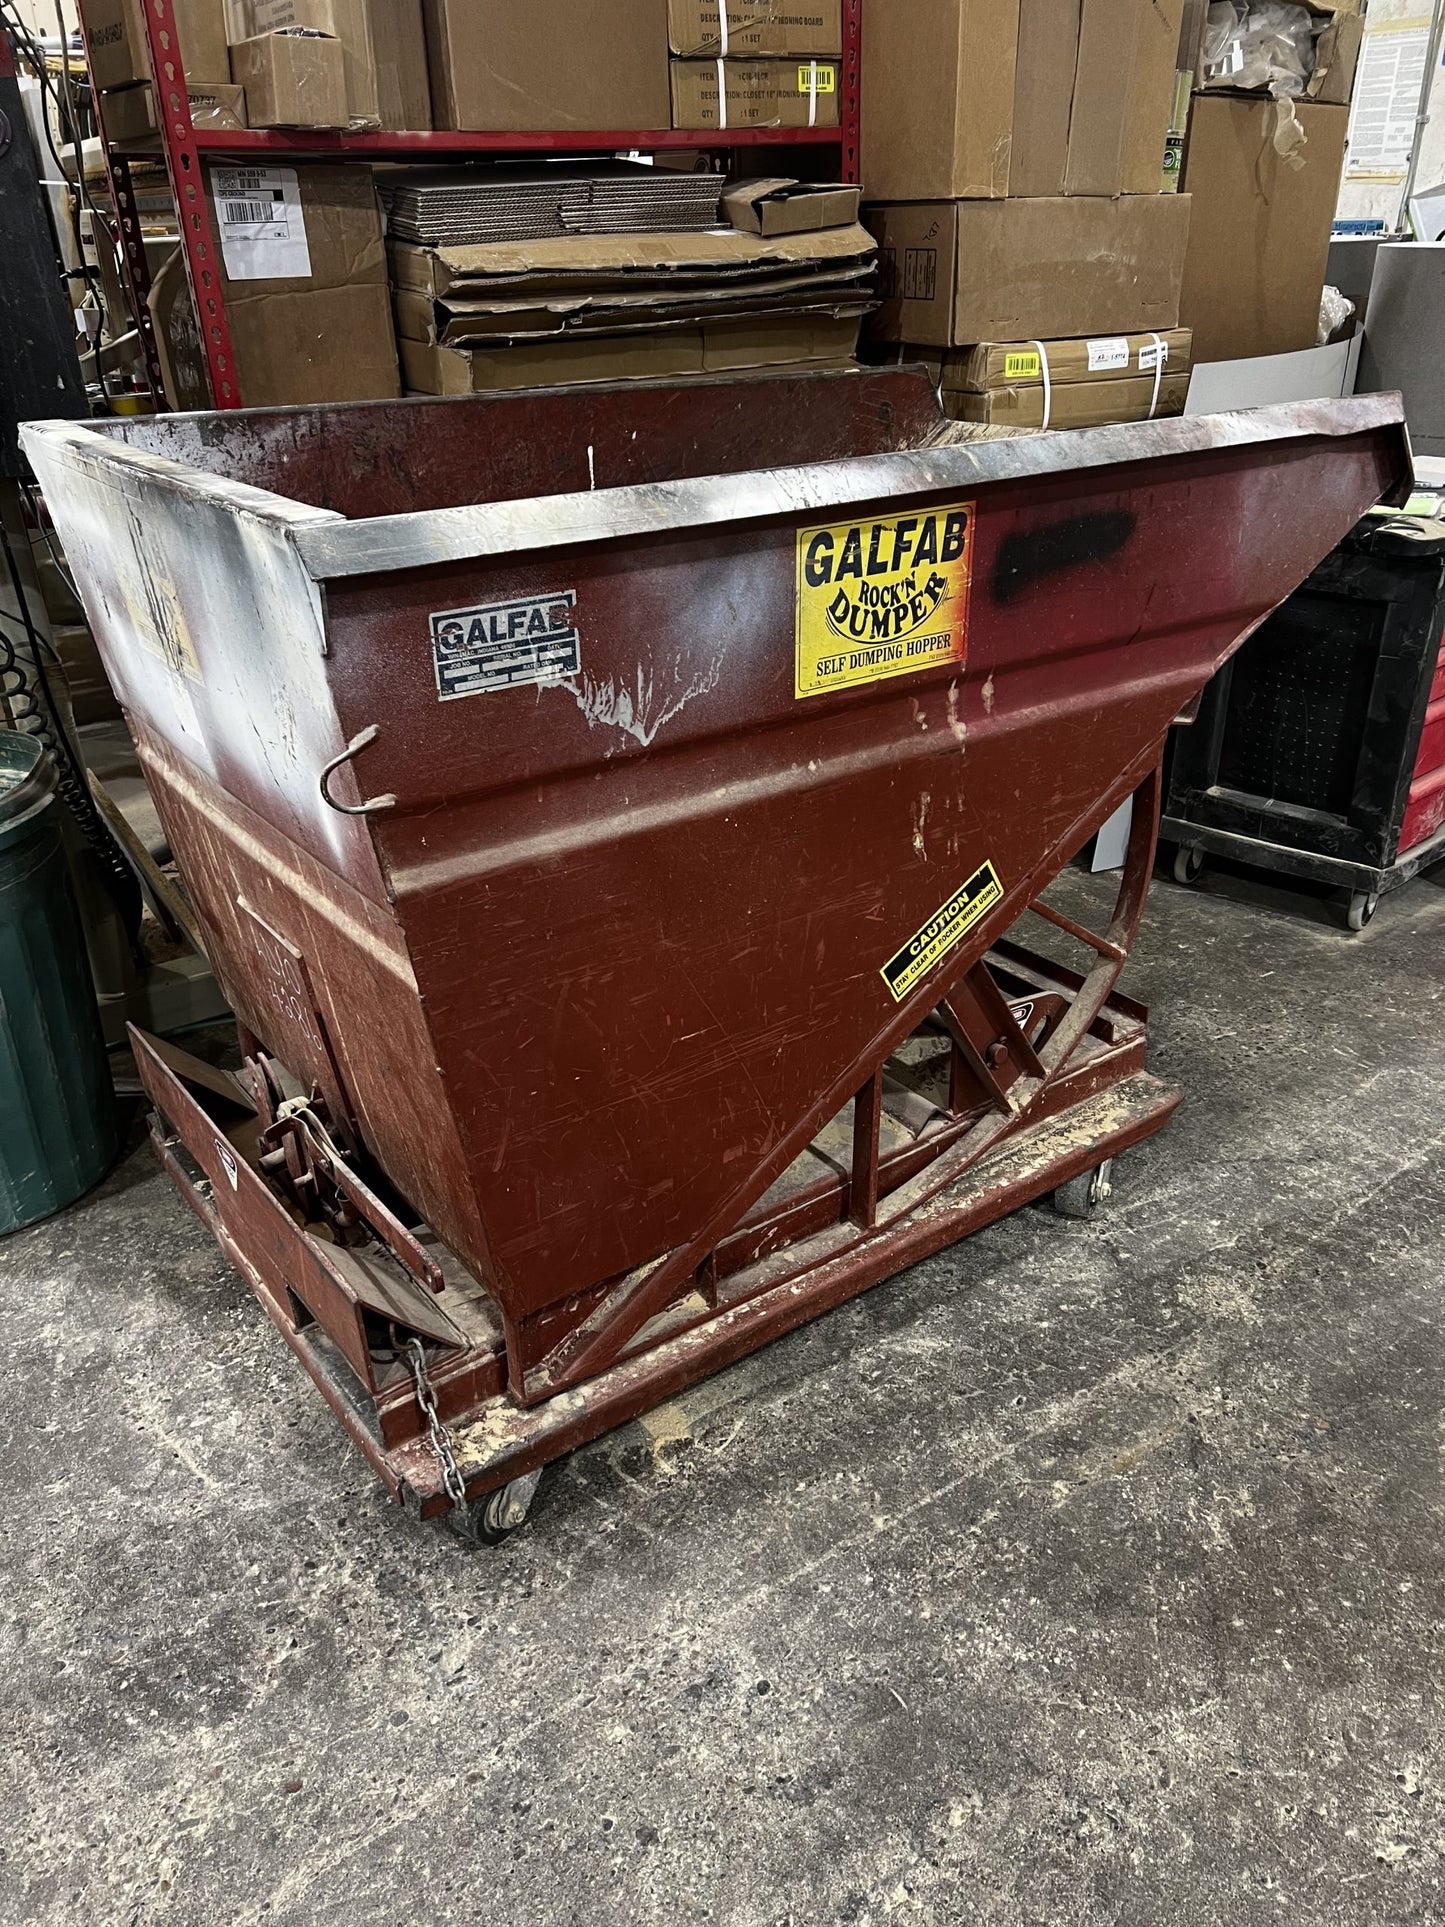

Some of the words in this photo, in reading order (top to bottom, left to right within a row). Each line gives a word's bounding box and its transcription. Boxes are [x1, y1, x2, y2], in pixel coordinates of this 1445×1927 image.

[778, 16, 802, 25] IRONING
[804, 17, 824, 26] BOARD
[750, 34, 760, 42] SET
[700, 72, 714, 80] ITEM
[743, 90, 764, 99] CLOSET
[702, 110, 714, 118] QTY
[748, 108, 759, 117] SET
[805, 512, 968, 588] GALFAB
[859, 571, 916, 607] ROCK'N
[828, 572, 947, 640] DUMPER
[440, 604, 568, 651] GALFAB
[477, 646, 500, 656] INDIANA
[816, 657, 847, 678] SELF
[849, 644, 902, 669] DUMPING
[906, 634, 952, 654] HOPPER
[450, 662, 460, 670] JOB
[468, 672, 485, 681] MODEL
[910, 892, 970, 956] CAUTION
[895, 972, 910, 990] STAY
[910, 954, 928, 974] CLEAR
[929, 946, 937, 955] OF
[939, 921, 961, 946] ROCKER
[962, 904, 978, 922] WHEN
[978, 886, 996, 904] USING
